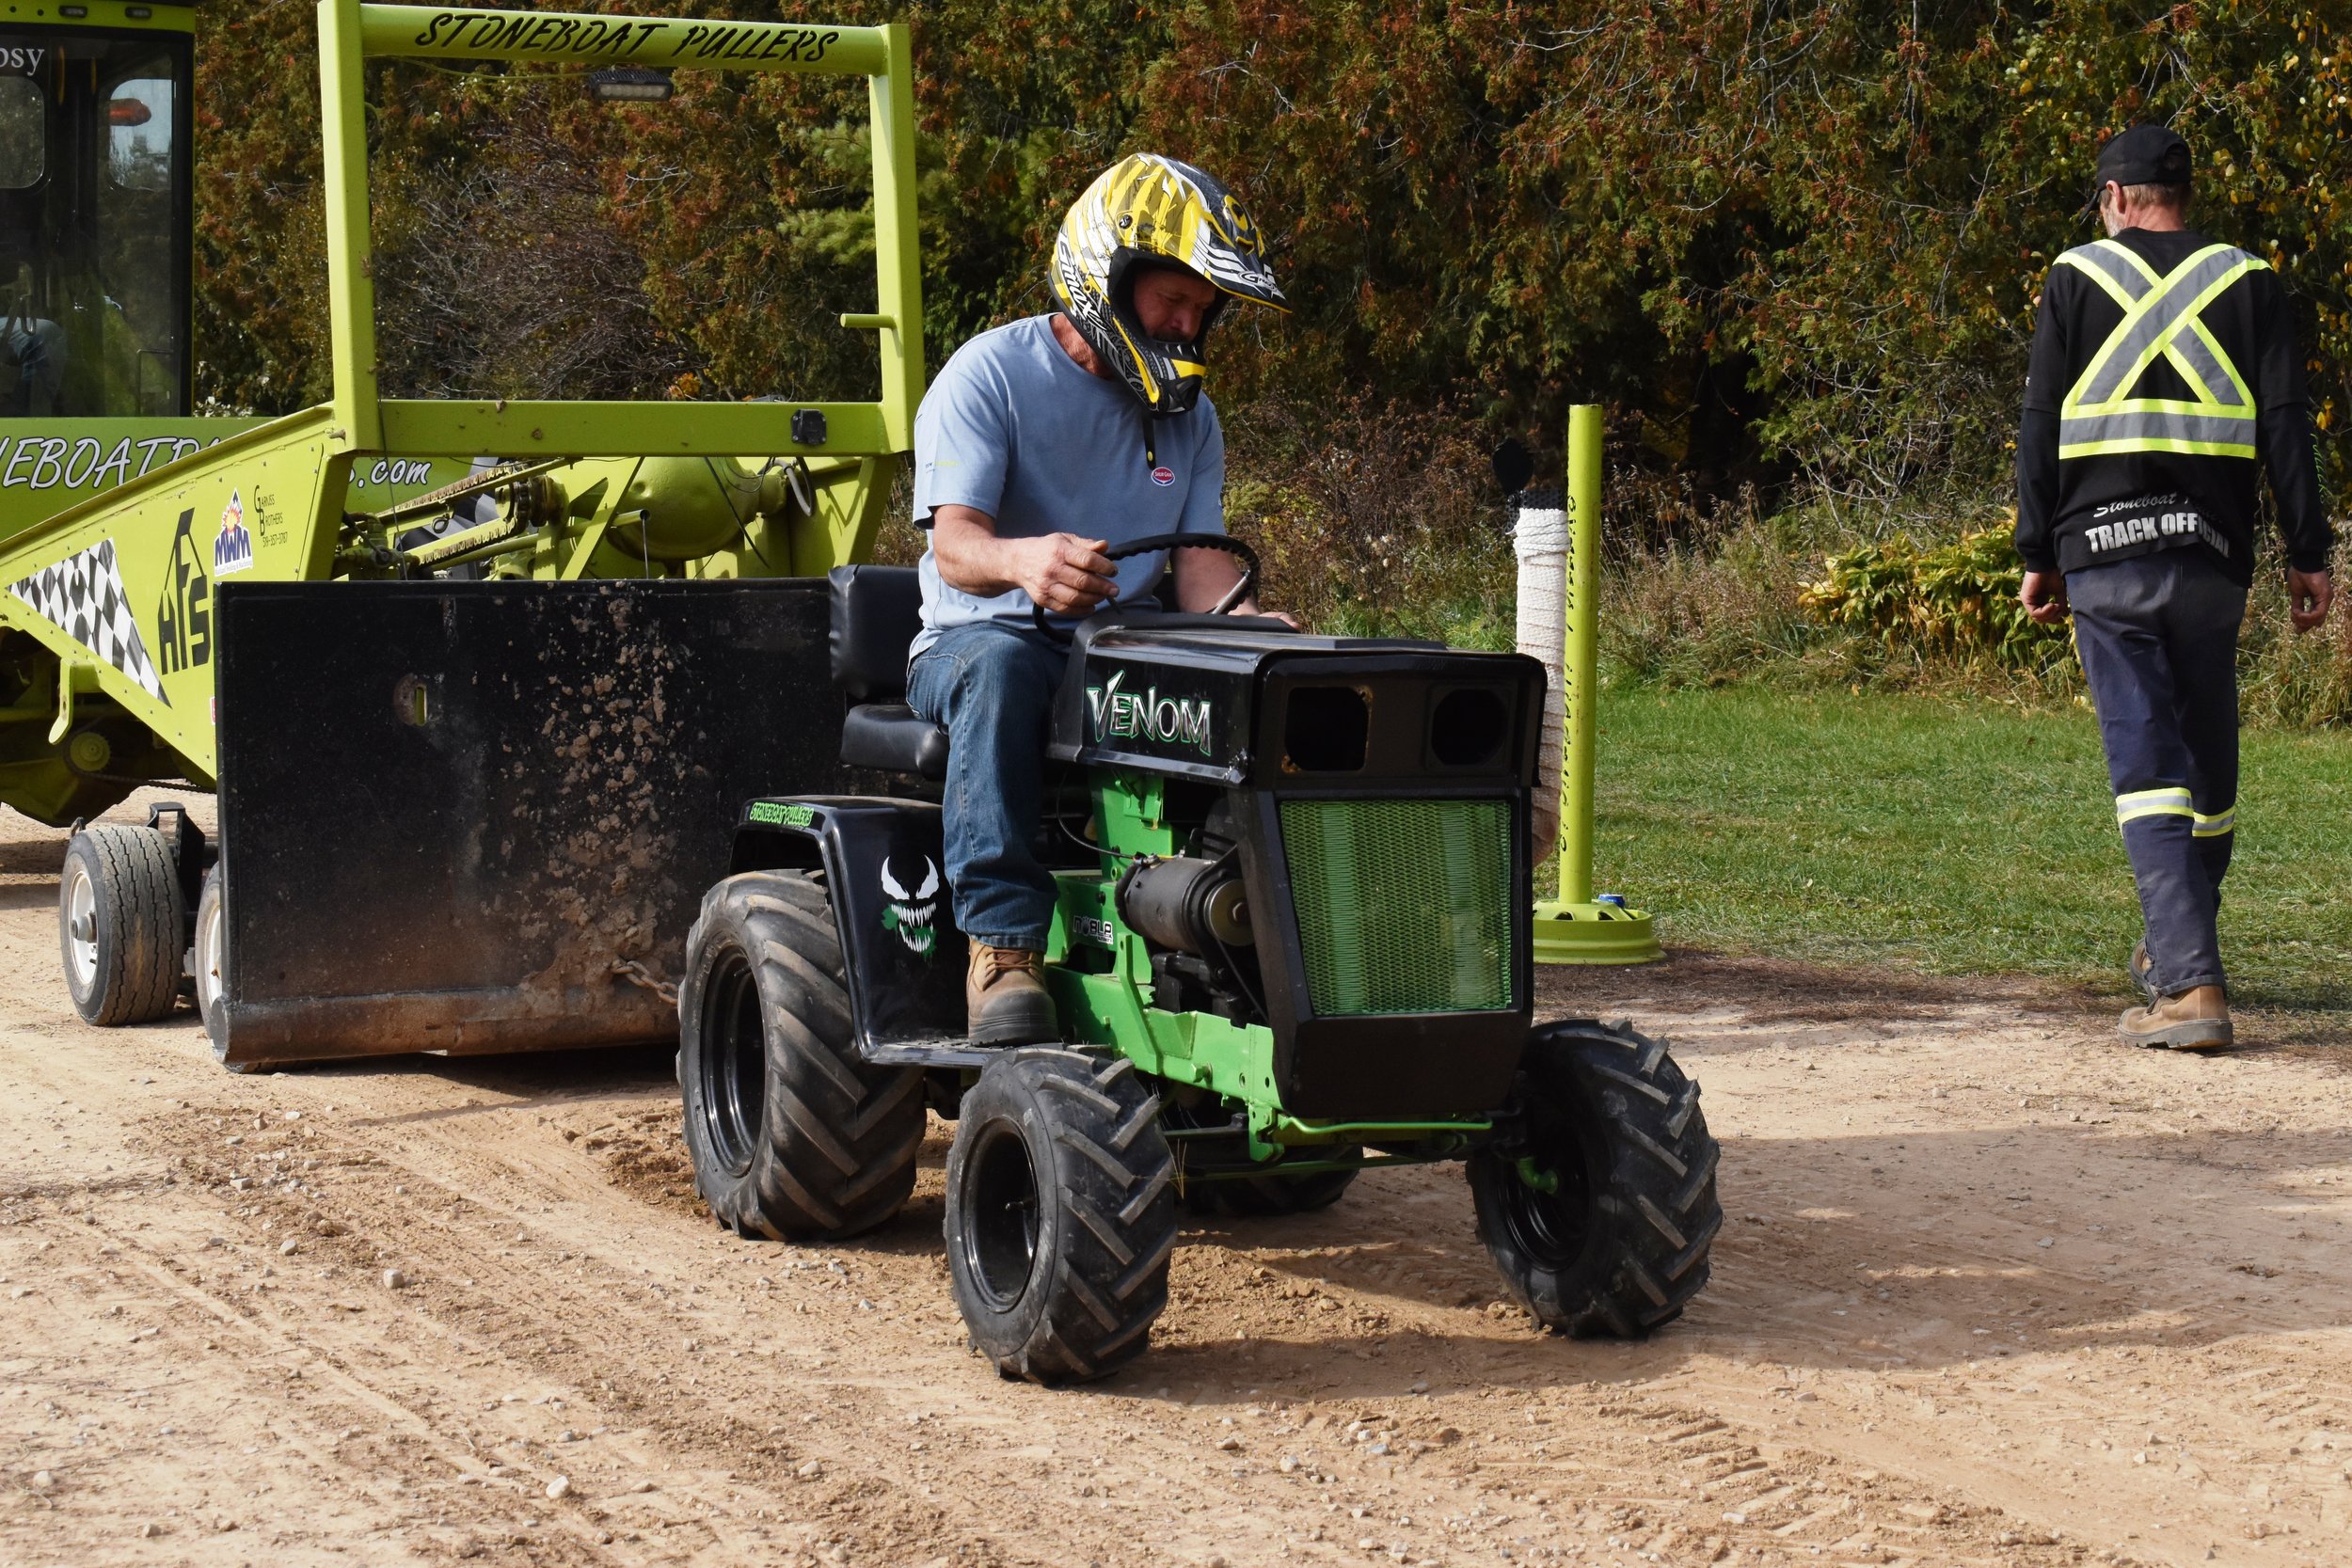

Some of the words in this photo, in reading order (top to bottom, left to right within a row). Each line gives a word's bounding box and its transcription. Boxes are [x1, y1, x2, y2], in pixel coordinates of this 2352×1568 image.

[415, 12, 670, 55] STONEBOAT
[671, 25, 840, 62] PULLERS
[2093, 492, 2177, 517] Stoneboat
[215, 524, 251, 566] MWM
[2085, 516, 2160, 553] TRACK
[1086, 669, 1211, 756] VENOM
